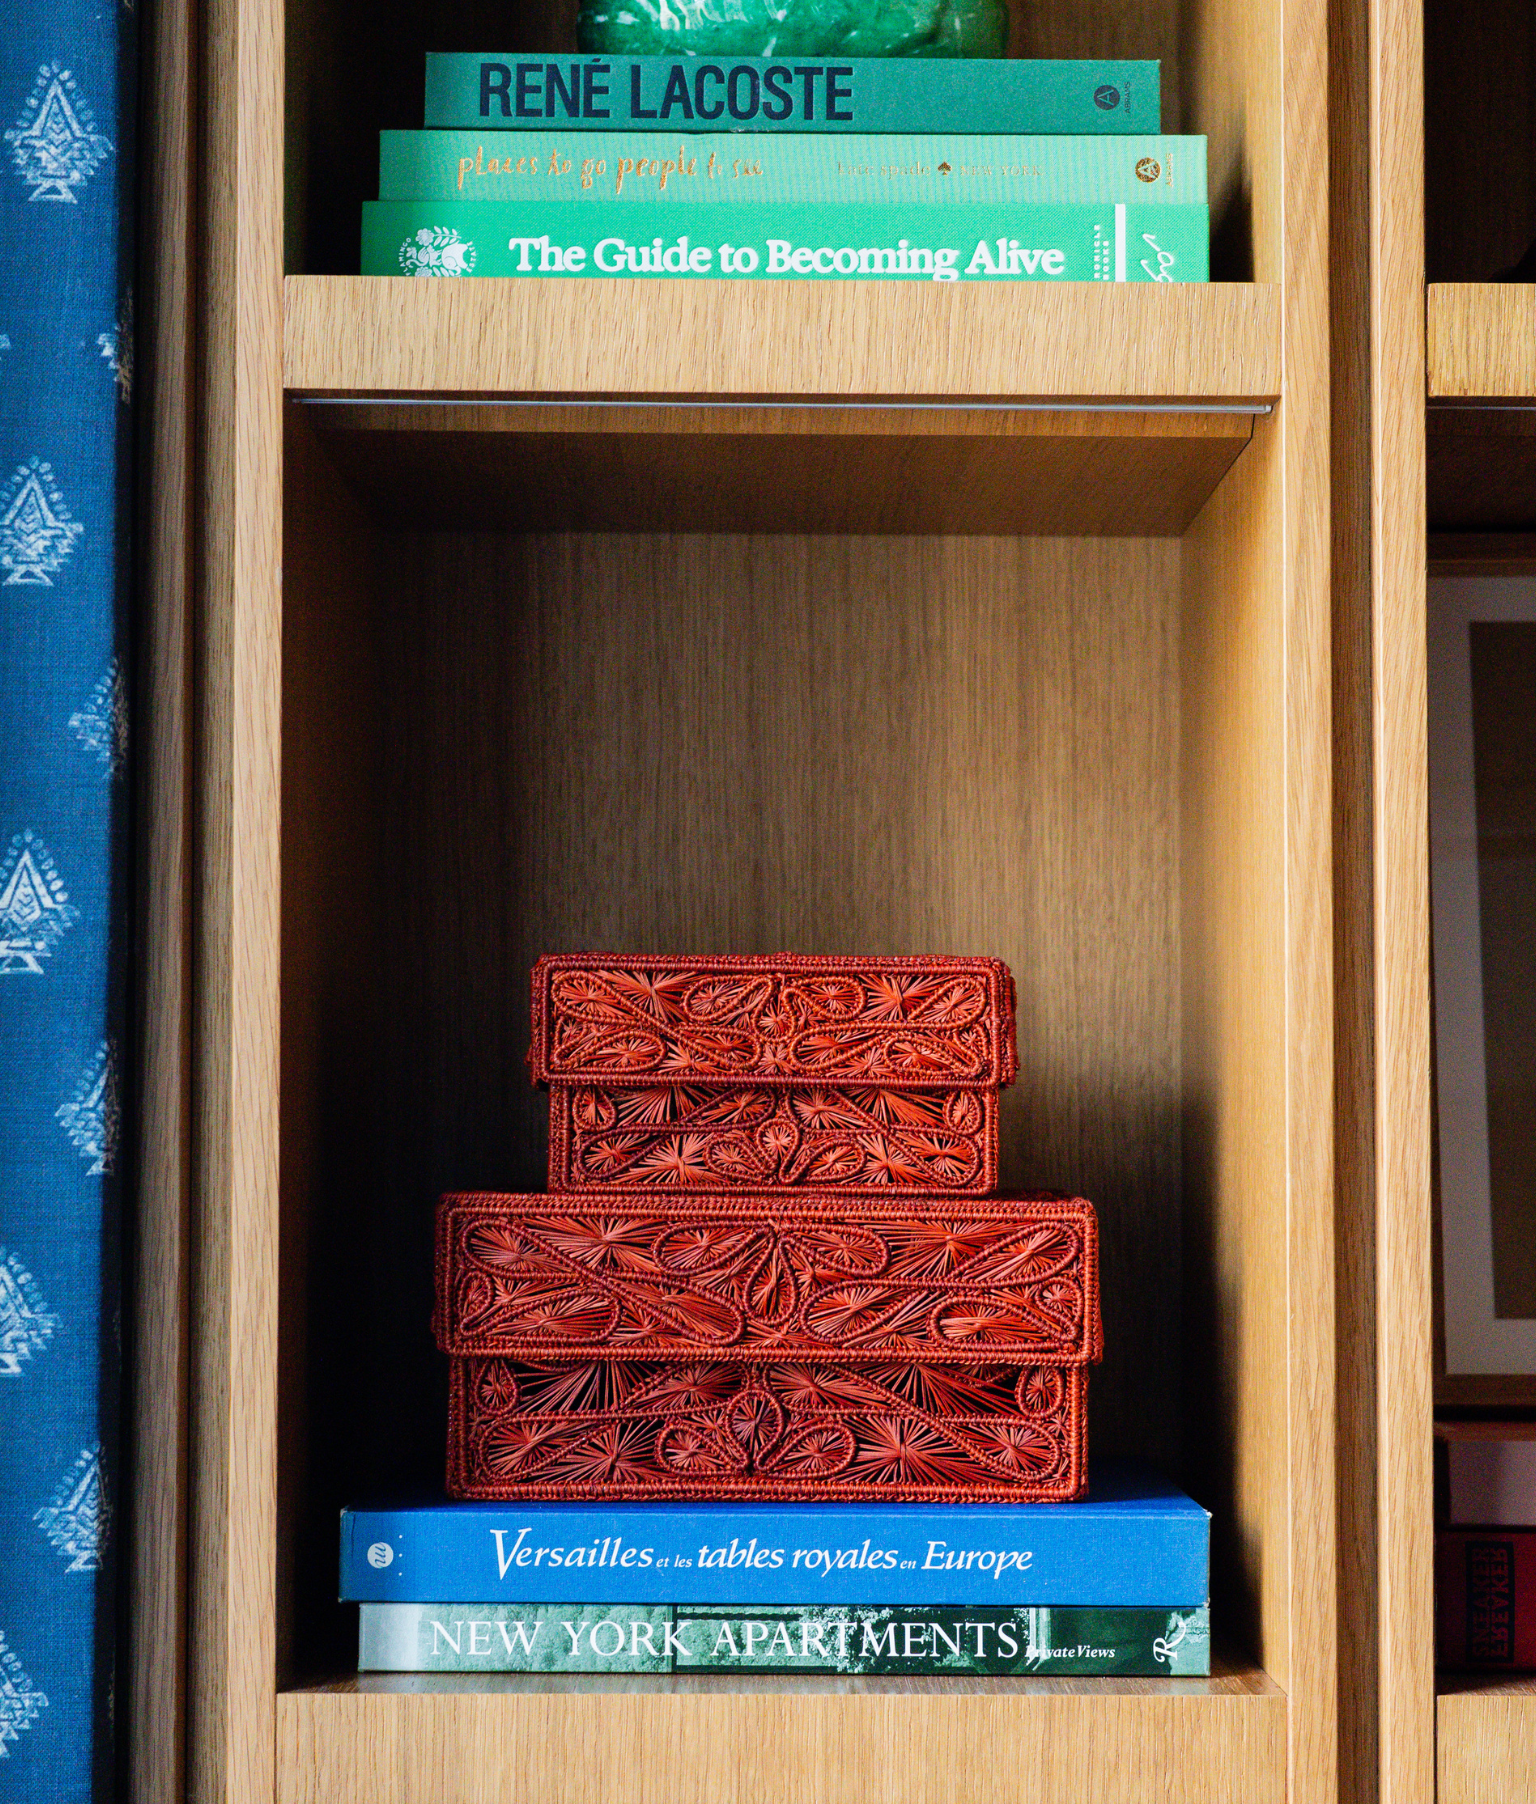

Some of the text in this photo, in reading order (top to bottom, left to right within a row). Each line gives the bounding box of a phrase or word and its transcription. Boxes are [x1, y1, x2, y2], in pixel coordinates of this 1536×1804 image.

[479, 58, 854, 121] RENÉ LACOSTE
[1123, 81, 1131, 114] ABRAMS
[457, 145, 538, 190] places
[548, 149, 572, 176] to
[581, 157, 606, 190] go
[616, 145, 697, 194] people
[733, 159, 764, 179] see
[837, 161, 1042, 180] kate spade NEW YORK
[1165, 153, 1174, 187] ABRAMS
[508, 235, 1065, 282] The Guide to Becoming Alive
[1093, 224, 1101, 279] RONICLE
[1102, 240, 1110, 280] BOOKS
[489, 1528, 1033, 1580] Versailles et les tables royales en Europe
[1472, 1547, 1490, 1657] SNEAKER
[429, 1621, 1018, 1658] NEW YORK APARTMENTS
[1076, 1645, 1116, 1658] Views
[1153, 1621, 1187, 1662] R
